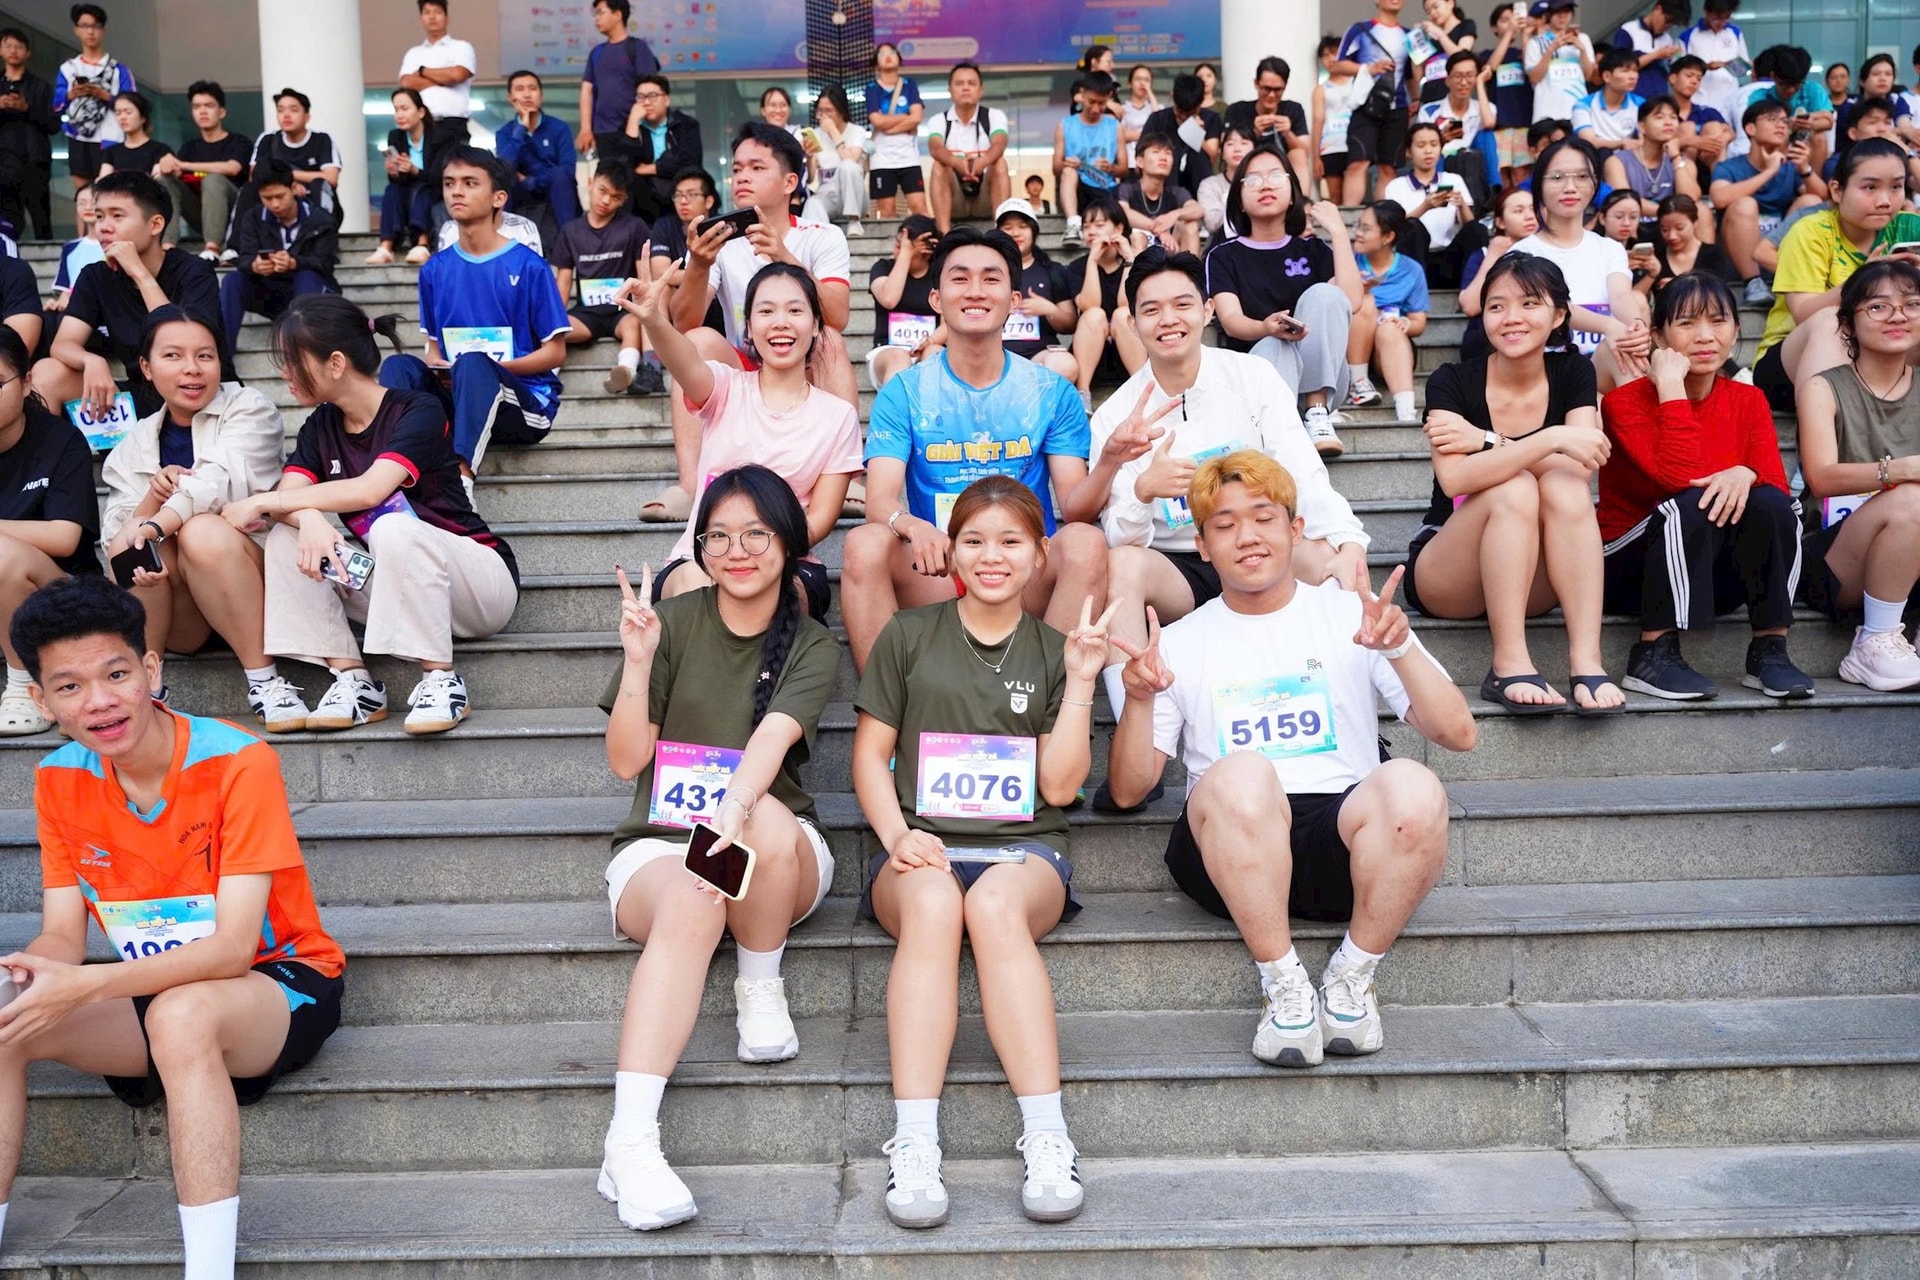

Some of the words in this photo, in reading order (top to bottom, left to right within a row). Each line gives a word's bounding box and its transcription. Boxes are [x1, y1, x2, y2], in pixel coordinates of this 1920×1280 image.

[588, 294, 613, 305] 115
[894, 328, 930, 339] 4019
[1003, 680, 1035, 693] VLU
[1231, 710, 1321, 745] 5159
[664, 782, 727, 812] 431
[930, 772, 1022, 802] 4076
